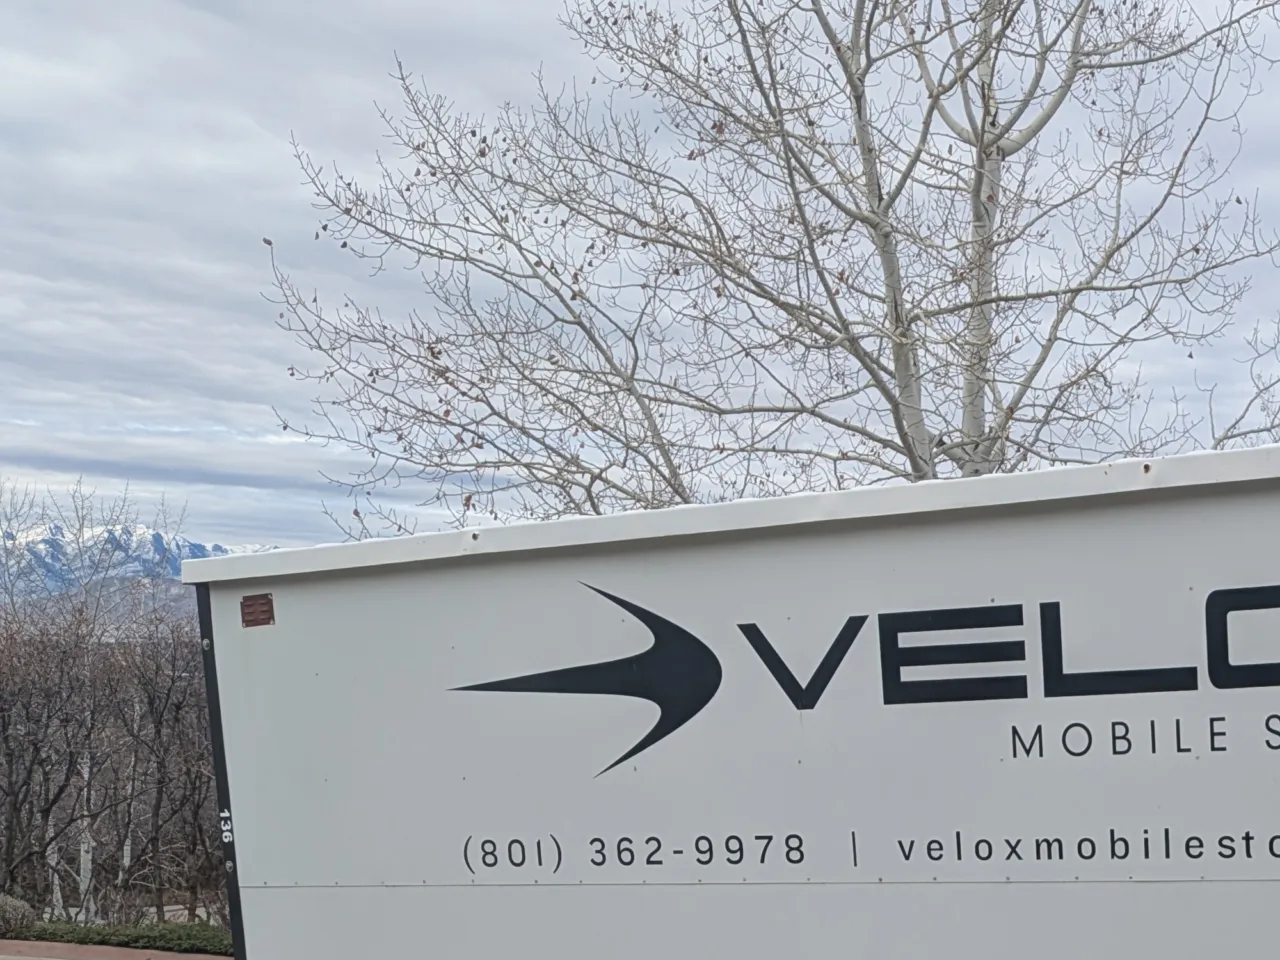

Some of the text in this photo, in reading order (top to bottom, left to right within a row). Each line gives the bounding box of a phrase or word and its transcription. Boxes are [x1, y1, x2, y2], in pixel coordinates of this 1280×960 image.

[1011, 716, 1228, 759] MOBILE
[220, 809, 233, 843] 136
[463, 834, 563, 875] (801)
[589, 834, 805, 868] 362-9978
